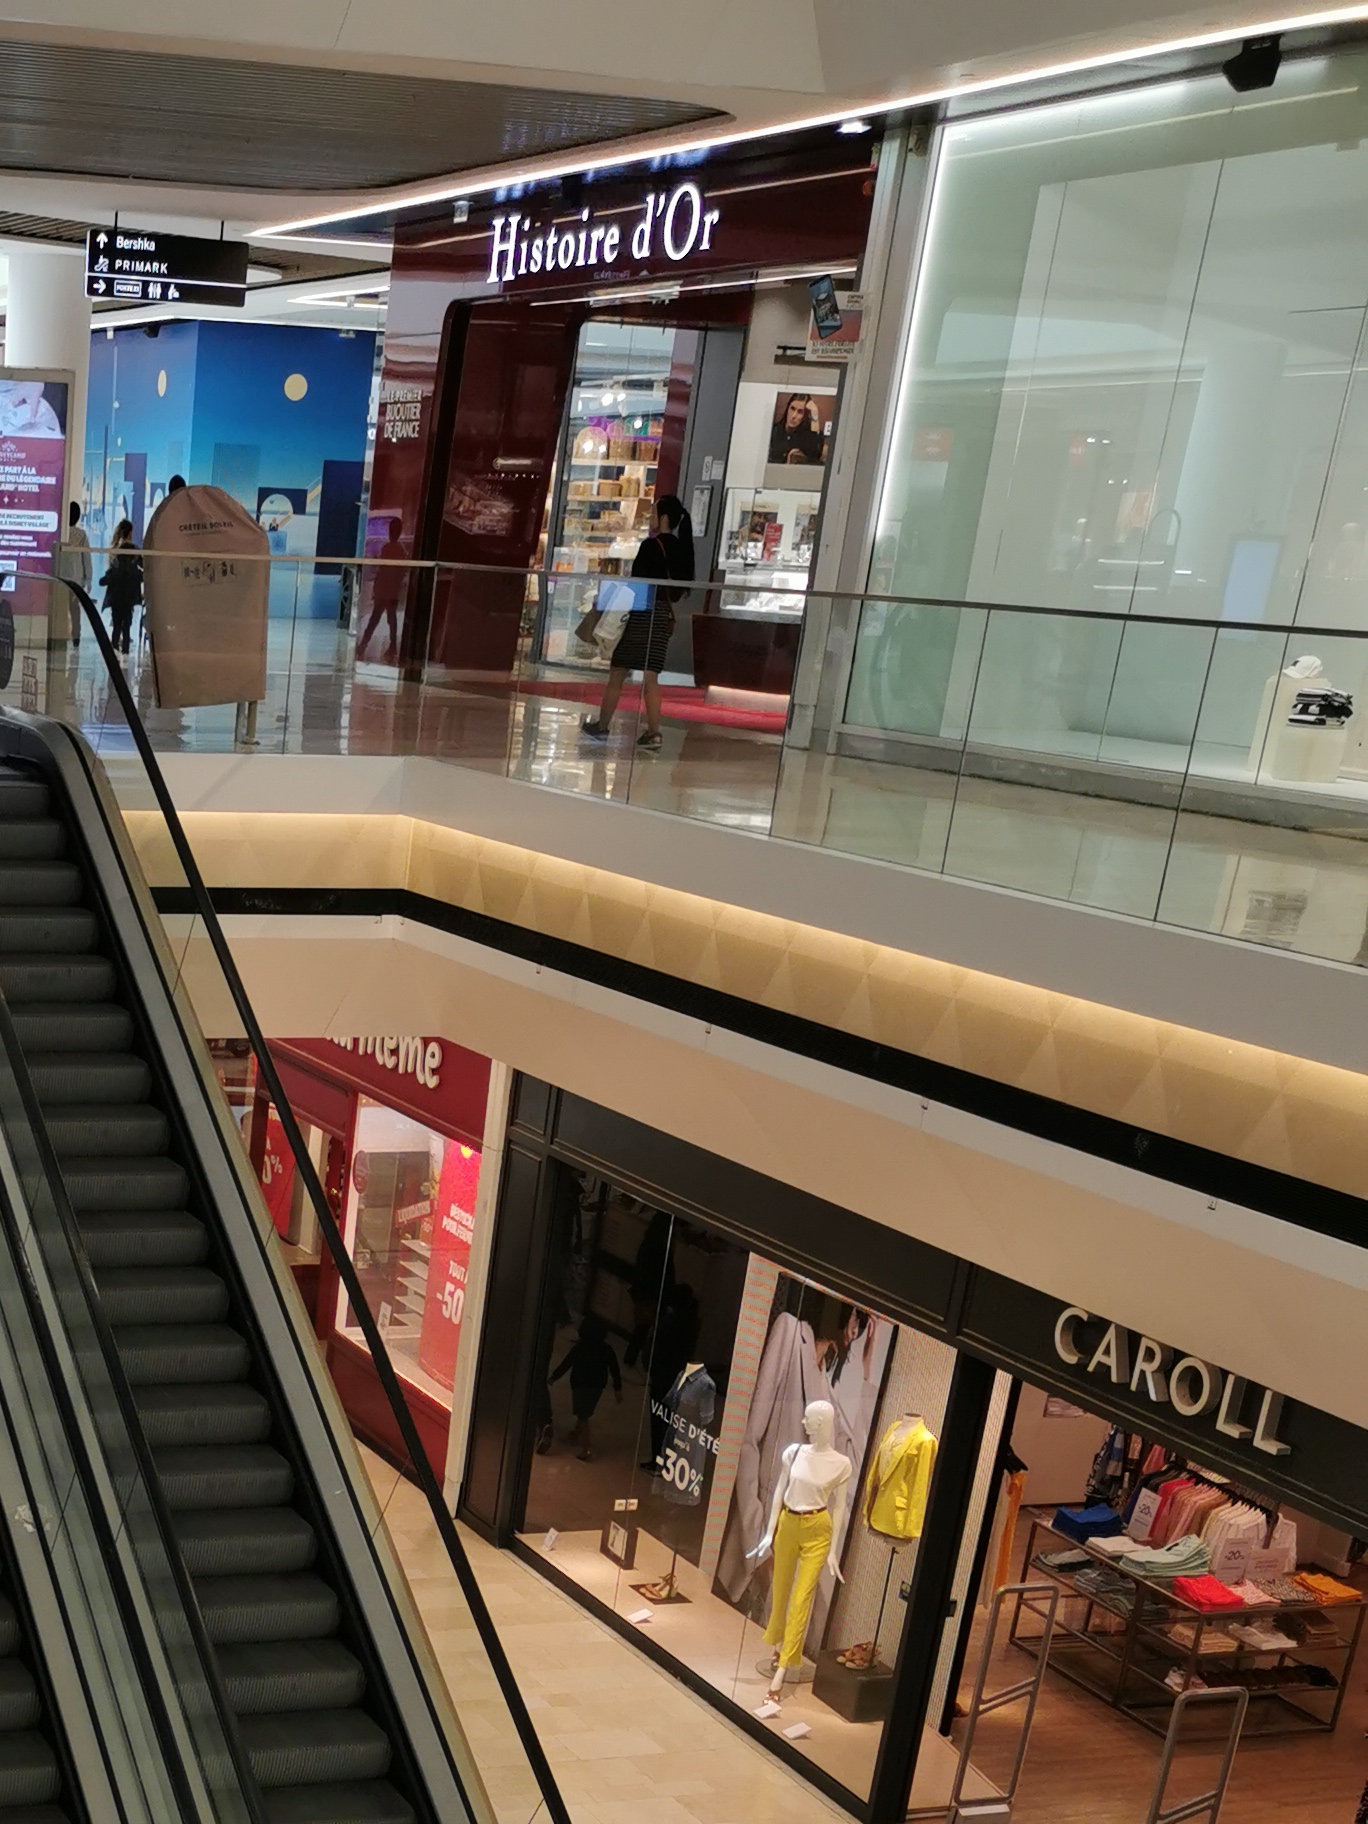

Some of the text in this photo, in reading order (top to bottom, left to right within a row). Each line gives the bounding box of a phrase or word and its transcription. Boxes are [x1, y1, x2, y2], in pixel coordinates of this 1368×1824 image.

[116, 236, 156, 251] Bershka
[486, 183, 720, 283] Histoire d'Or
[114, 259, 168, 274] PRIMARK
[1054, 1306, 1292, 1456] CAROLL
[651, 1398, 721, 1455] VALISE D'ÉTÉ
[655, 1447, 704, 1497] -30%
